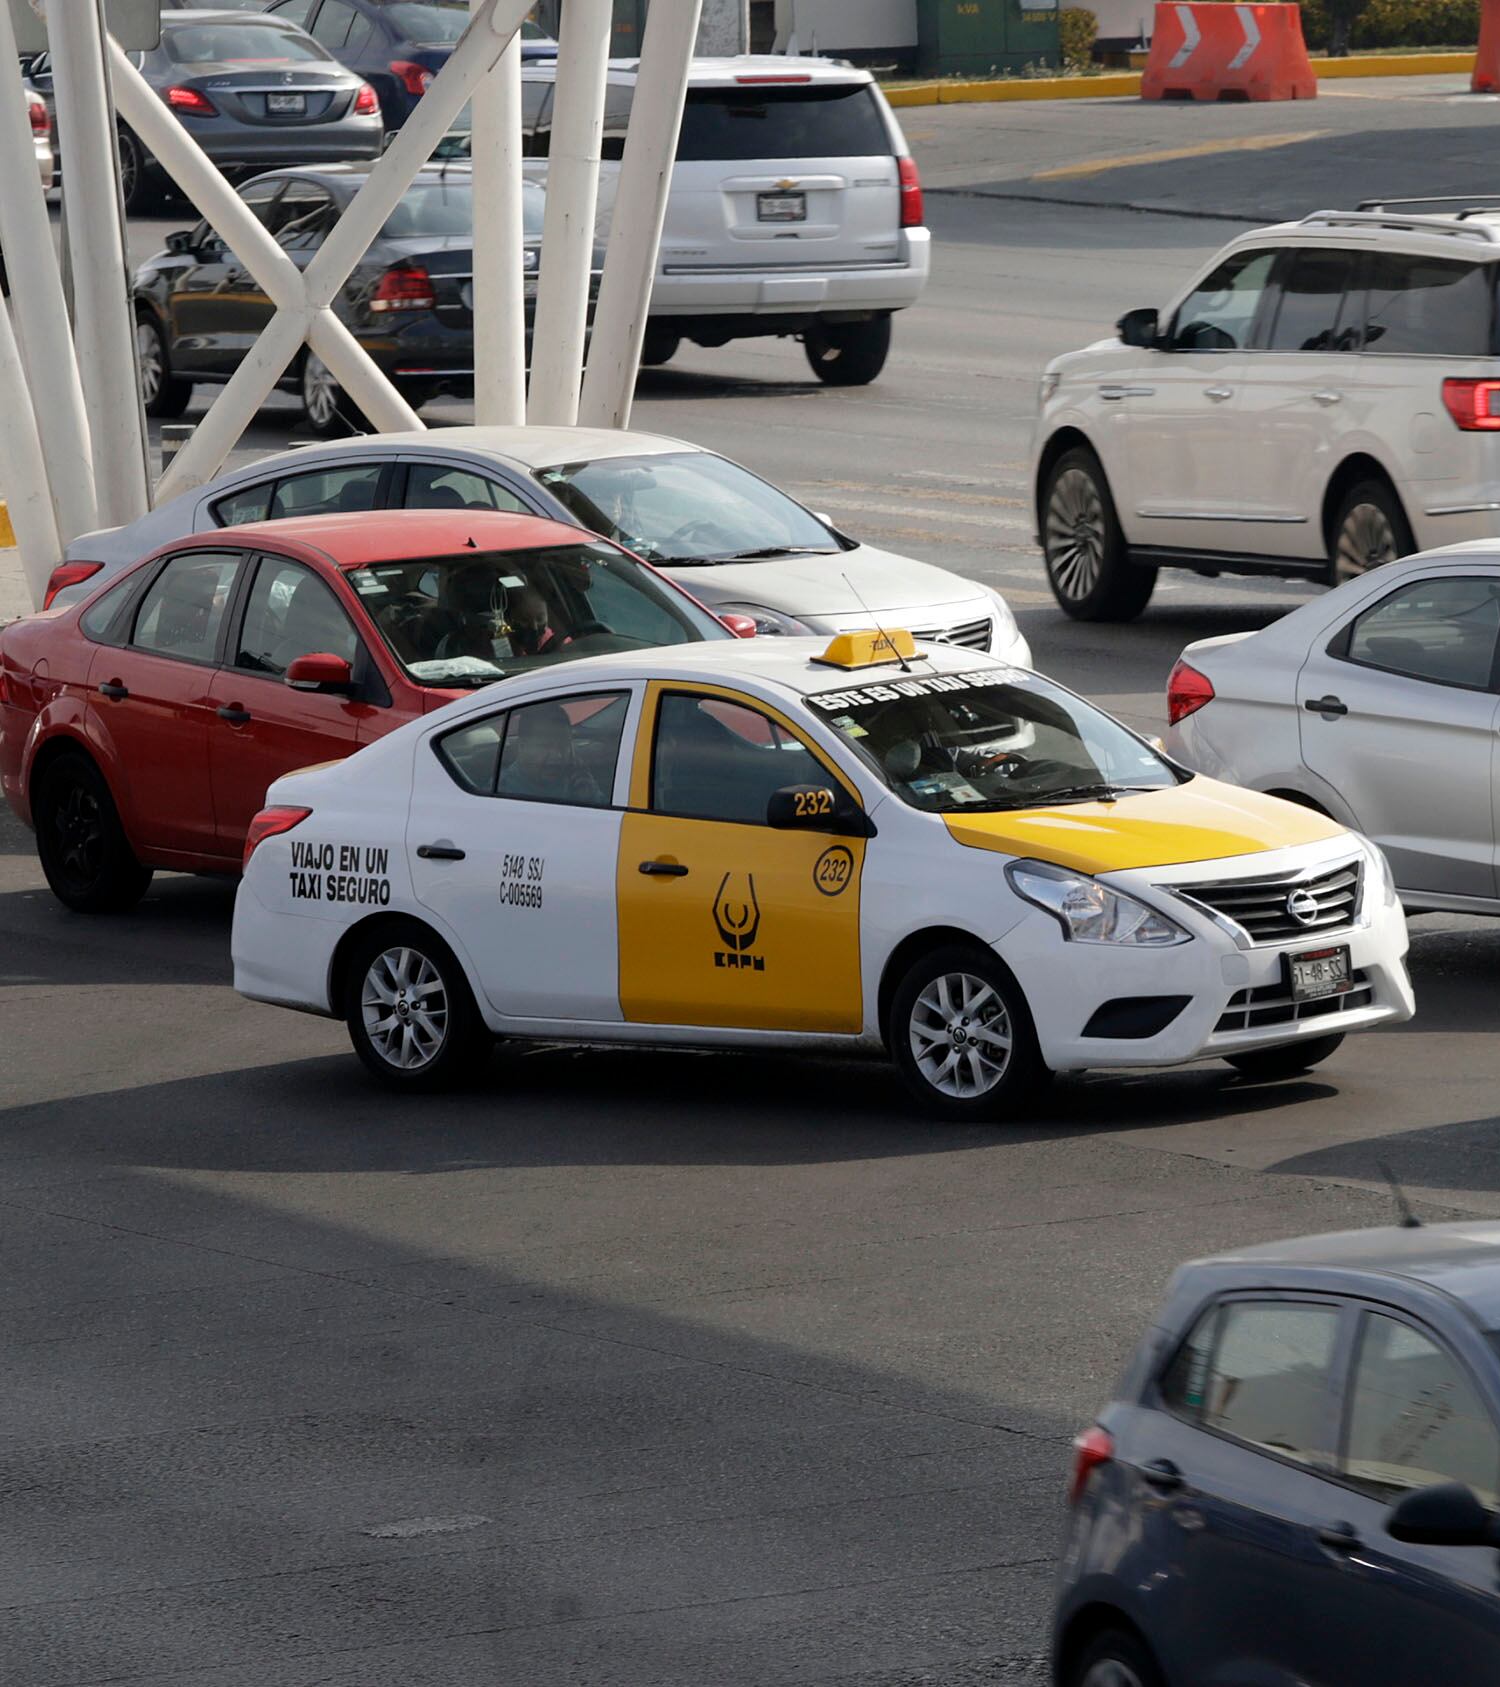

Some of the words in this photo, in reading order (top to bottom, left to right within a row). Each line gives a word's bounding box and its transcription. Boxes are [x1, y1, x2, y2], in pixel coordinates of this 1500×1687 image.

[808, 691, 873, 711] ESTE
[866, 685, 899, 703] ES
[891, 680, 931, 697] UN
[920, 673, 970, 692] TAXI
[958, 668, 1031, 688] SEGURO
[794, 791, 831, 816] 232
[291, 841, 334, 870] VIAJO
[340, 845, 360, 872] EN
[365, 849, 388, 875] UN
[502, 854, 525, 879] 5148
[527, 857, 545, 881] SSJ
[820, 859, 846, 881] 232
[289, 872, 321, 899] TAXI
[326, 874, 391, 906] SEGURO
[500, 881, 543, 909] C-005569
